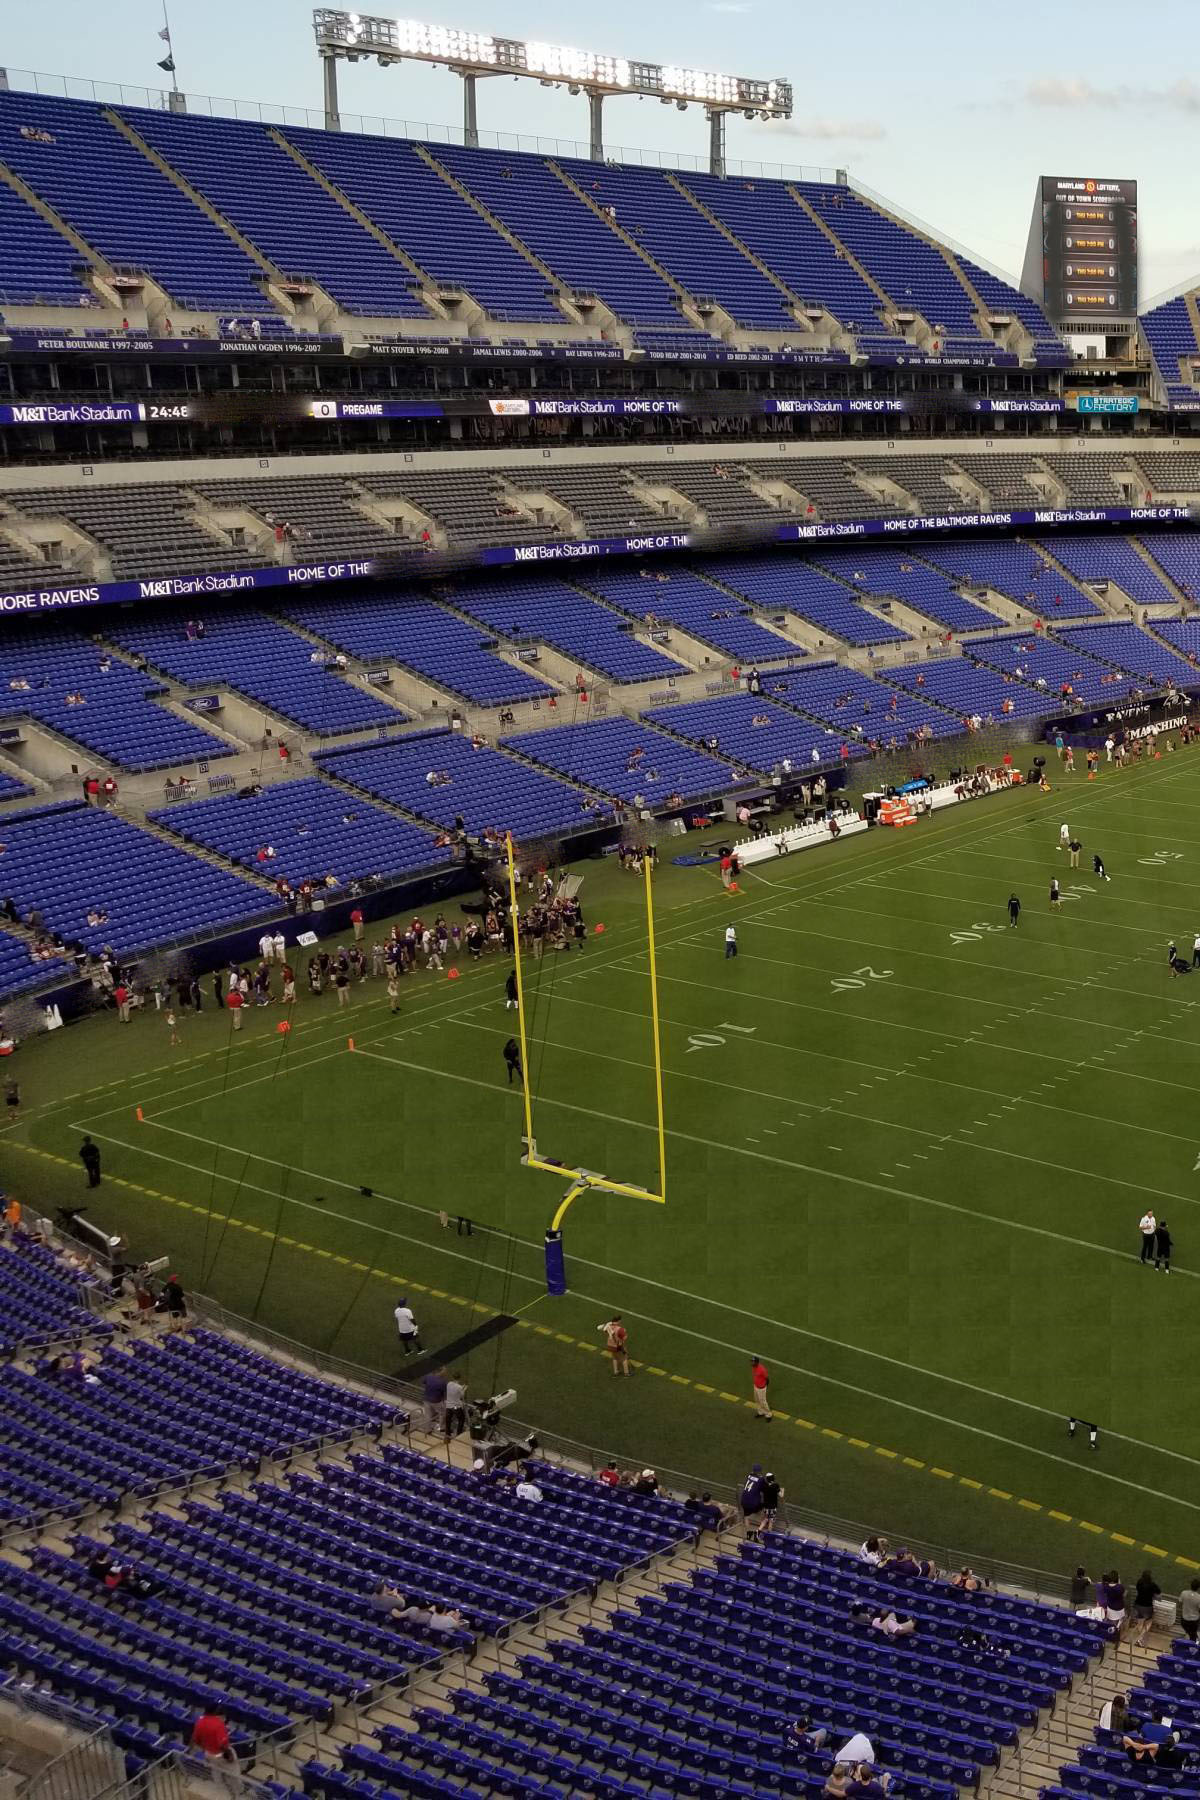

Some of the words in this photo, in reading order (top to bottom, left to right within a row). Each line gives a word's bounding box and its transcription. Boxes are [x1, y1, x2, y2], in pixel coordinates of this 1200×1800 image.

[1057, 182, 1085, 190] MARYLAND
[38, 340, 64, 348] PETER
[66, 341, 110, 350] BOULWARE
[112, 342, 153, 350] 1997-2005
[220, 343, 257, 351] JONATHAN
[258, 343, 283, 352] OGDEN
[286, 344, 321, 352] 1996-2007
[391, 346, 414, 354] STOVER
[473, 348, 492, 356] JAMAL
[321, 404, 330, 415] 0
[342, 404, 383, 415] PREGAME
[535, 402, 558, 413] M&T
[558, 402, 580, 412] Bank
[580, 402, 615, 412] Stadium
[624, 402, 650, 412] HOME
[652, 402, 664, 411] OF
[776, 401, 796, 411] M&T
[796, 401, 813, 411] Bank
[814, 401, 842, 411] Stadium
[850, 401, 872, 410] HOME
[873, 401, 884, 410] OF
[886, 401, 901, 410] THE
[990, 400, 1010, 410] M&T
[1010, 401, 1029, 411] Bank
[1030, 400, 1060, 411] Stadium
[12, 407, 48, 422] M&T
[48, 407, 80, 420] Bank
[81, 406, 131, 420] Stadium
[1035, 512, 1055, 522] M&T
[1056, 512, 1074, 521] Bank
[1075, 510, 1106, 520] Stadium
[1130, 509, 1157, 518] HOME
[1159, 509, 1171, 517] OF
[1173, 508, 1188, 517] THE
[798, 526, 817, 538] M&T
[817, 525, 835, 536] Bank
[836, 524, 864, 534] Stadium
[884, 521, 907, 530] HOME
[908, 520, 919, 528] OF
[921, 519, 935, 527] THE
[936, 516, 979, 526] BALTIMORE
[980, 514, 1011, 524] RAVENS
[515, 547, 539, 560] M&T
[540, 547, 562, 558] Bank
[563, 544, 600, 557] Stadium
[626, 539, 654, 550] HOME
[656, 537, 669, 548] OF
[140, 580, 173, 598] M&T
[174, 578, 205, 594] Bank
[206, 575, 254, 590] Stadium
[288, 568, 325, 581] HOME
[328, 565, 345, 576] OF
[40, 588, 100, 606] RAVENS
